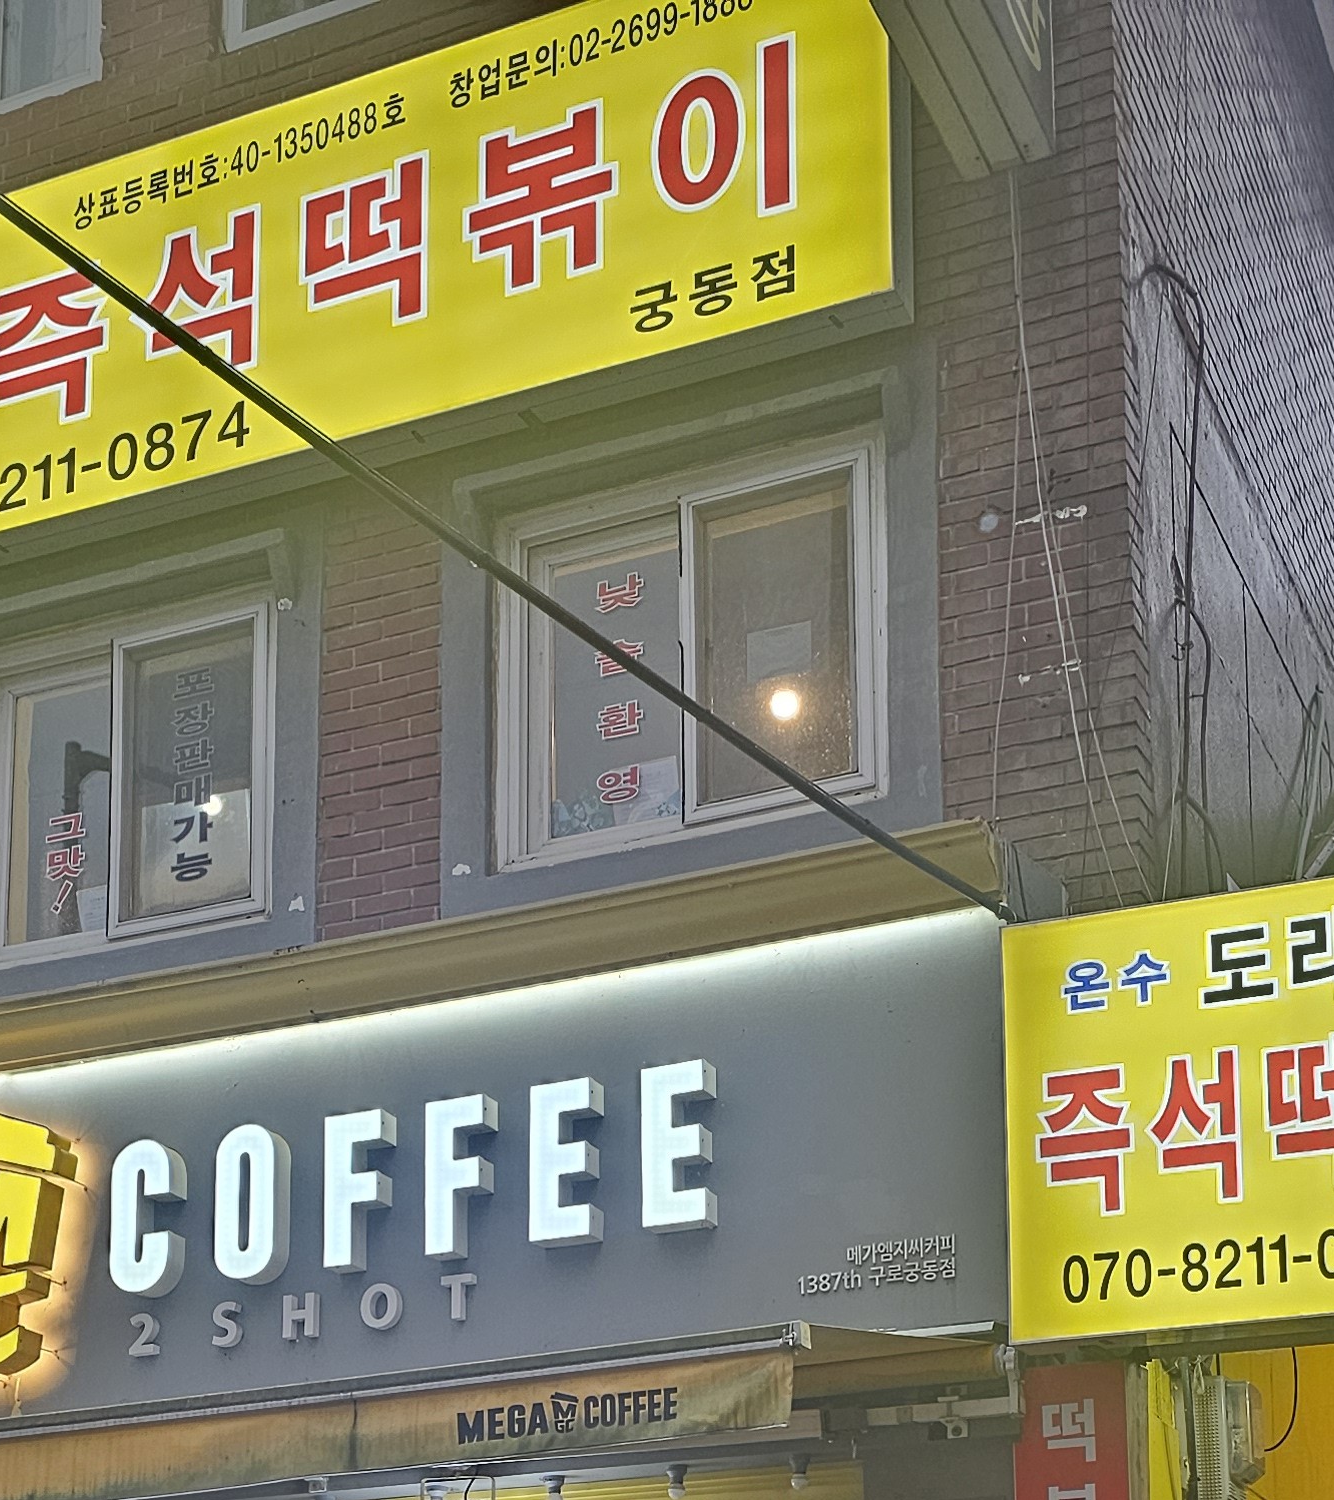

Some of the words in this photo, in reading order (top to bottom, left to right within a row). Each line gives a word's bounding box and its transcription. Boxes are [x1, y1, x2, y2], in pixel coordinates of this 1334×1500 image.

[629, 245, 798, 333] 궁동점
[1061, 950, 1170, 1014] 온수
[107, 1058, 718, 1299] COFFEE
[797, 1269, 861, 1295] 1387th
[868, 1257, 955, 1287] 구로궁동점
[846, 1233, 955, 1265] 메가엠지씨커피
[128, 1312, 162, 1358] 2
[211, 1272, 478, 1349] SHOT
[457, 1402, 549, 1445] MEGA
[583, 1387, 678, 1429] COFFEE
